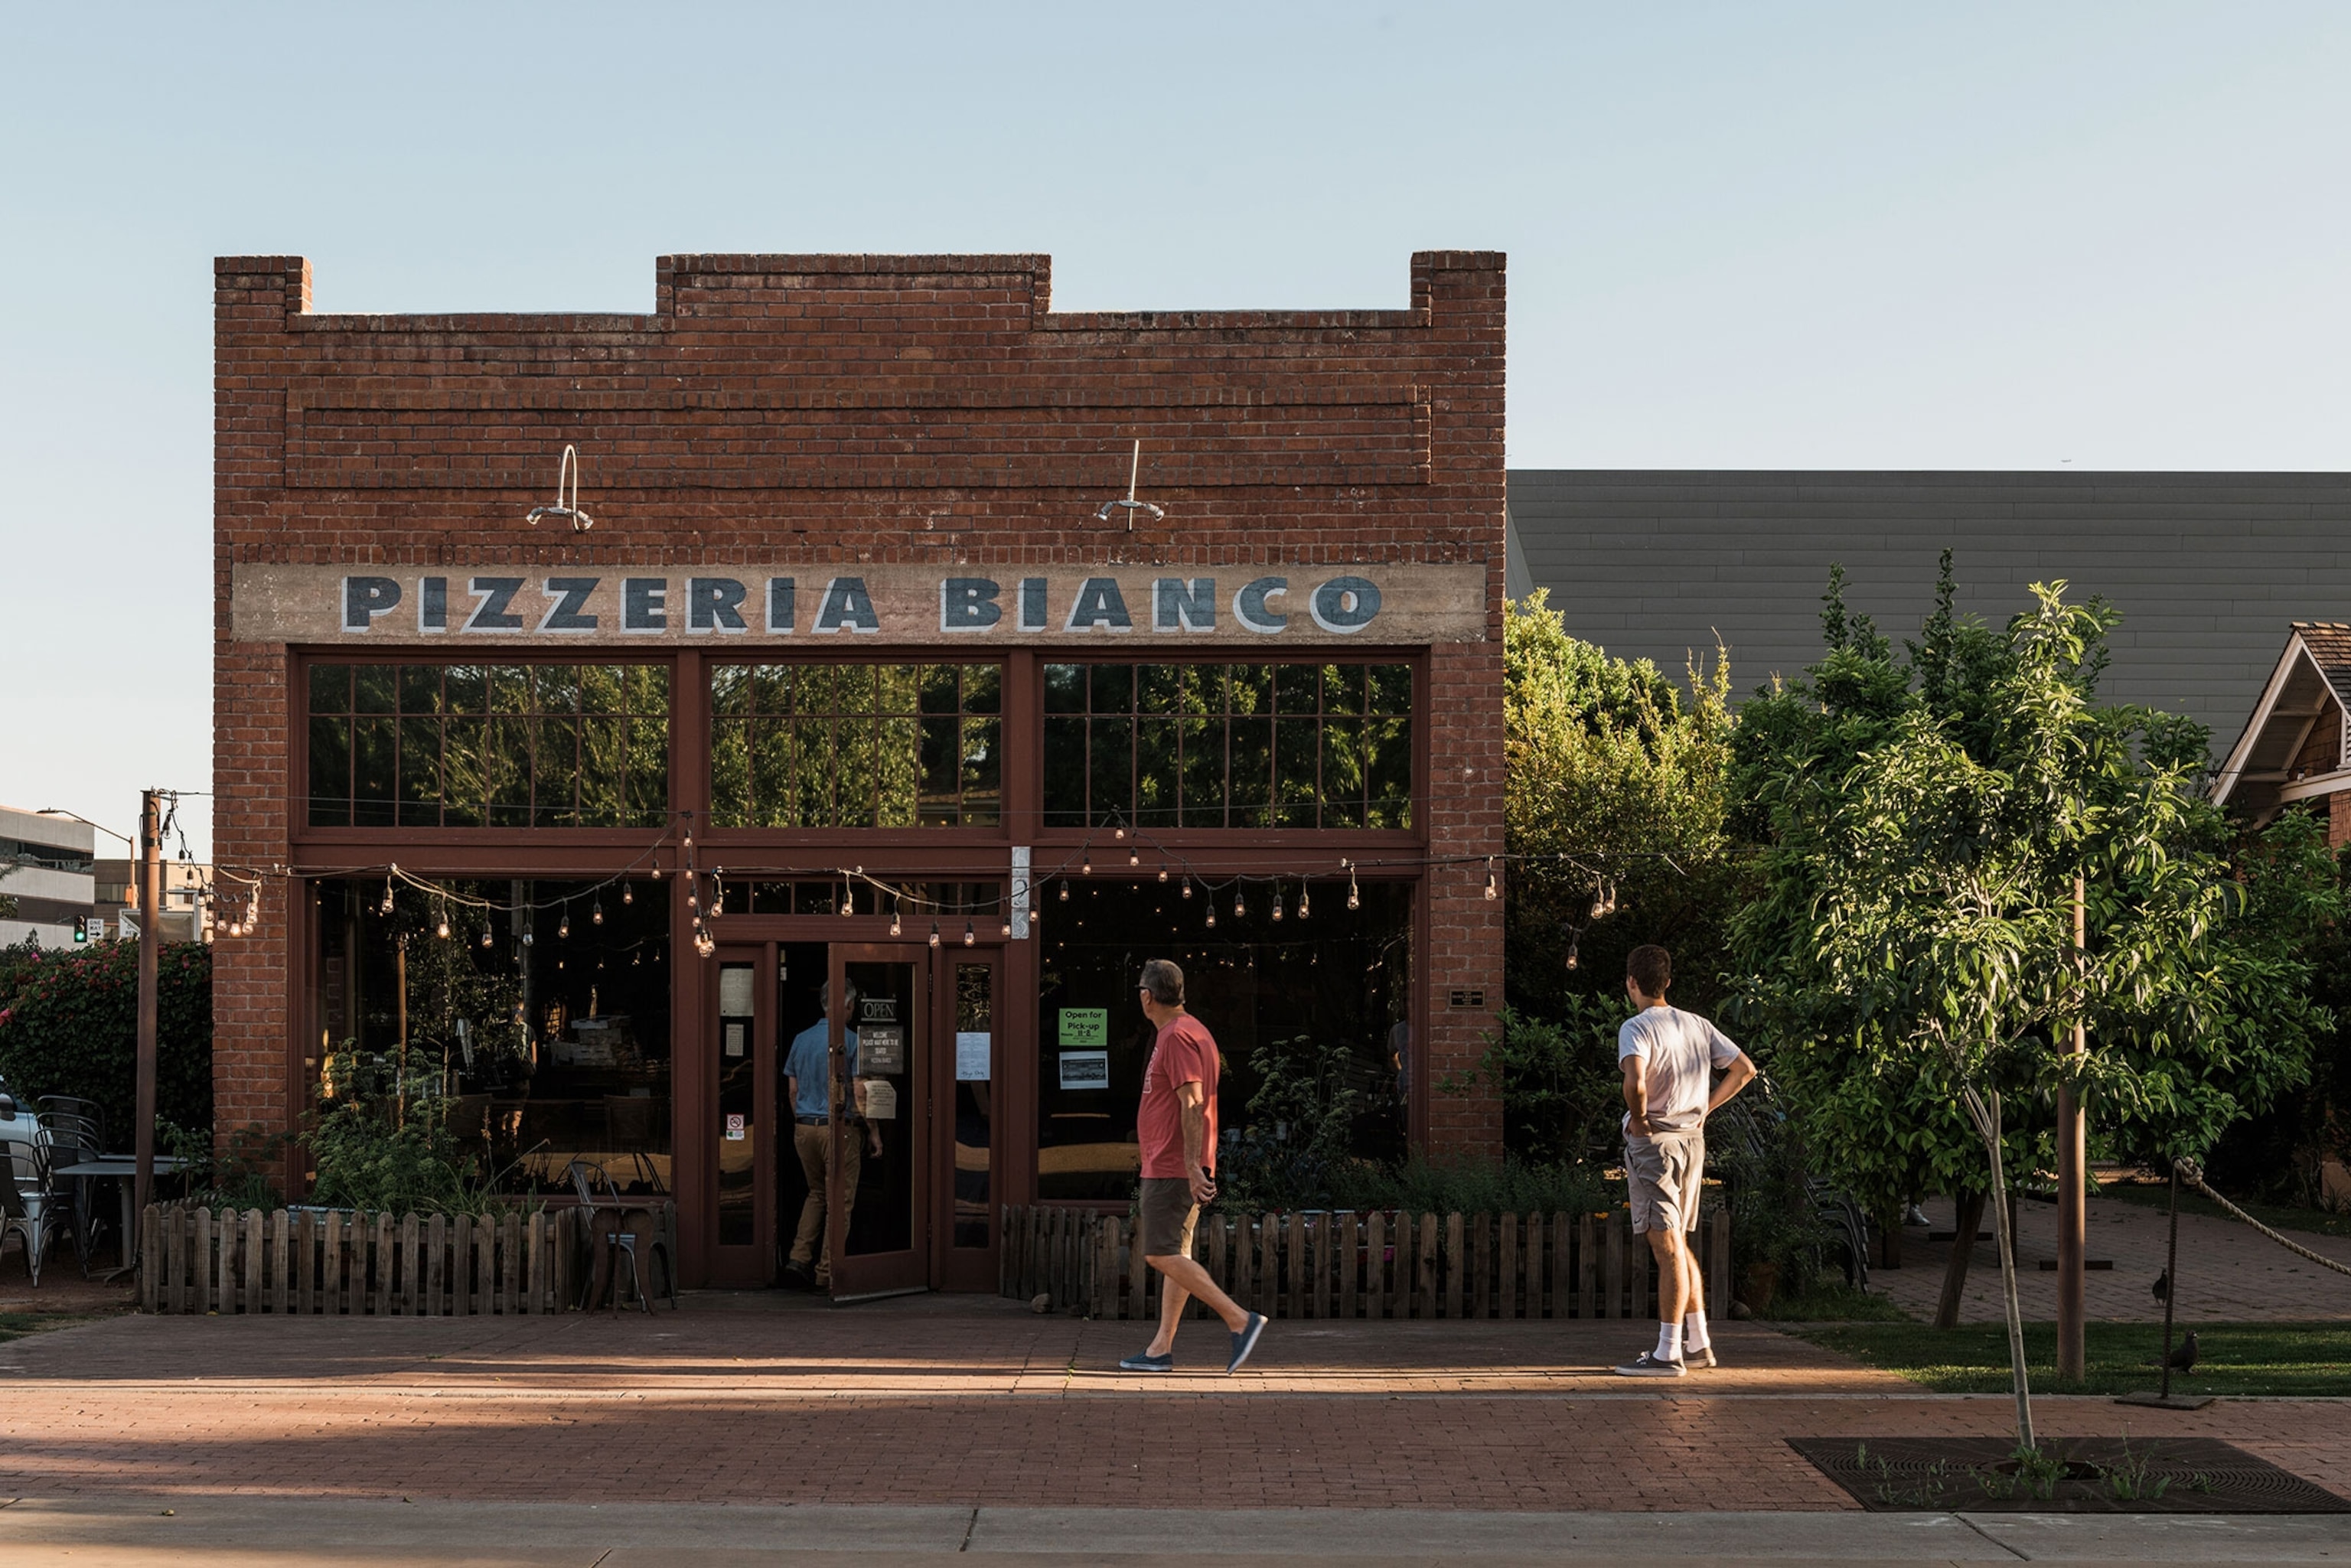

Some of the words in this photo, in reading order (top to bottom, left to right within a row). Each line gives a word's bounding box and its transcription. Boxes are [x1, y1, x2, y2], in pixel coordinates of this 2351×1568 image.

[341, 575, 880, 634] PIZZERIA
[939, 575, 1383, 634] BIANCO
[863, 1002, 894, 1018] OPEN
[1065, 1011, 1087, 1019] Open
[1068, 1022, 1100, 1031] Pick-up
